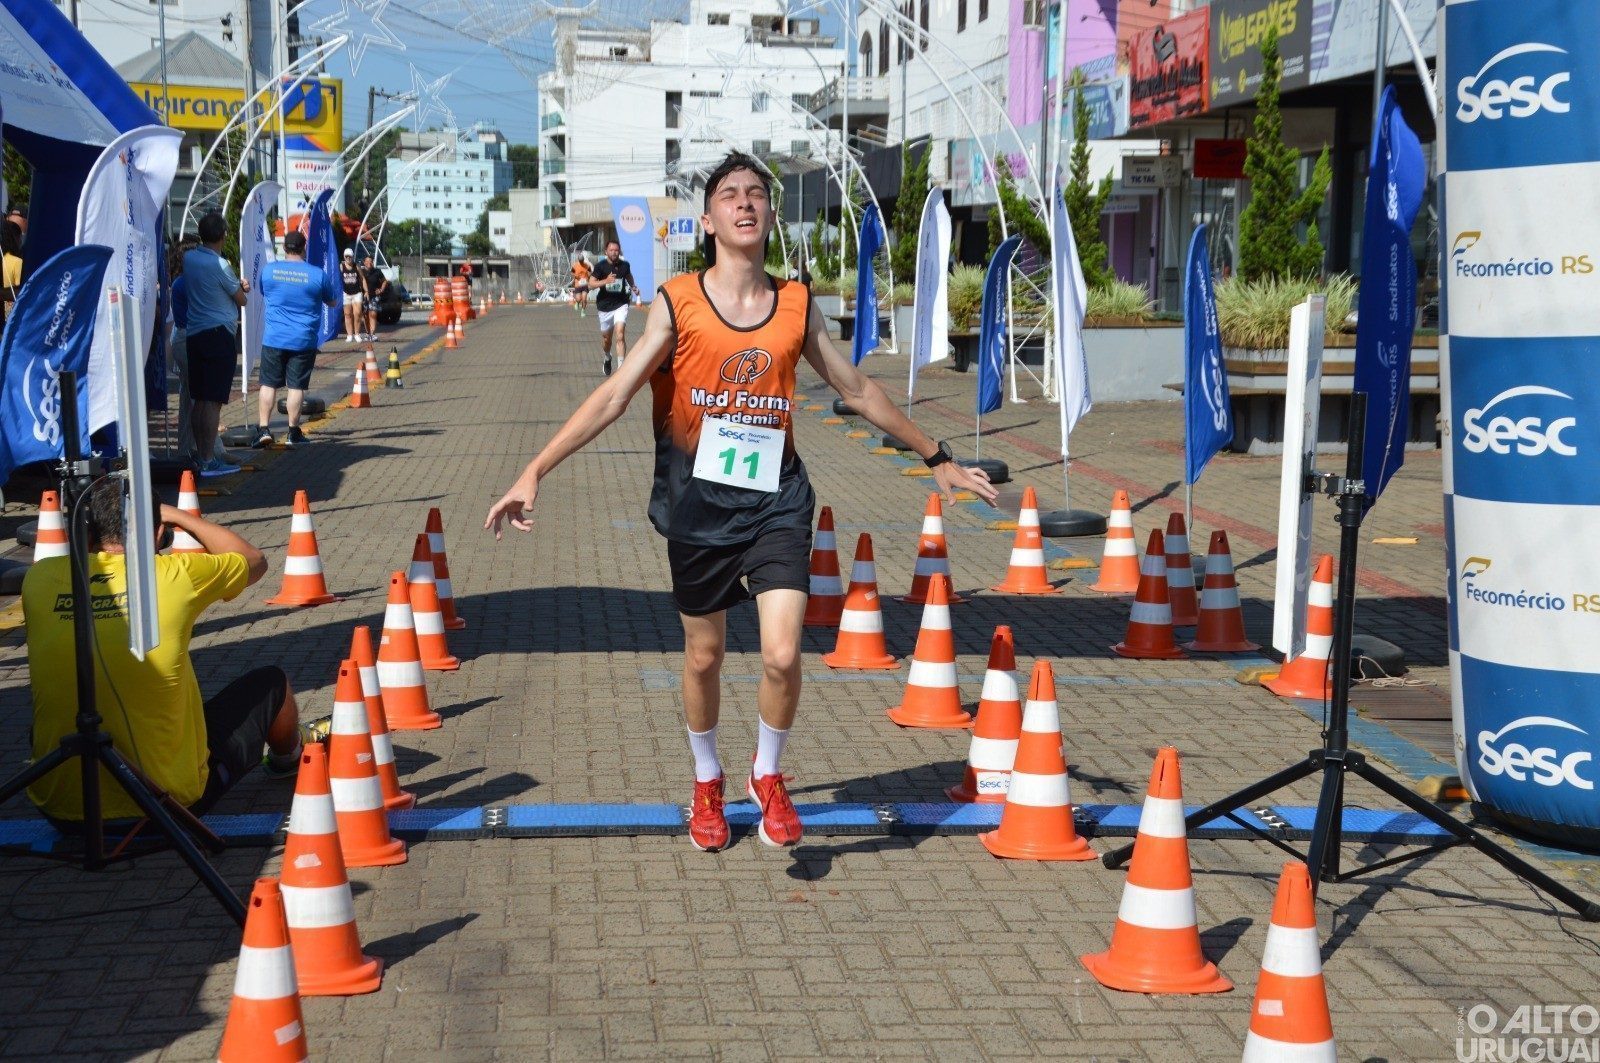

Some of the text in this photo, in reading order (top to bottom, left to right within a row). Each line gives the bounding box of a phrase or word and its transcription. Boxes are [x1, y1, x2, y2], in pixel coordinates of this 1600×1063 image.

[1456, 71, 1571, 123] Sesc
[1387, 182, 1398, 221] Sesc
[1388, 242, 1398, 322] Sindicatos
[1456, 255, 1594, 277] Fecomércio RS
[44, 270, 73, 346] Fecomércio
[58, 308, 76, 351] Senac
[1389, 344, 1398, 364] RS
[33, 358, 64, 447] Sesc
[690, 387, 791, 412] Med Forma
[718, 427, 746, 441] Sesc
[1463, 407, 1578, 457] Sesc
[718, 447, 760, 480] 11
[1466, 582, 1600, 612] Fecomércio RS
[1478, 730, 1594, 790] Sesc
[979, 780, 1002, 788] Sesc
